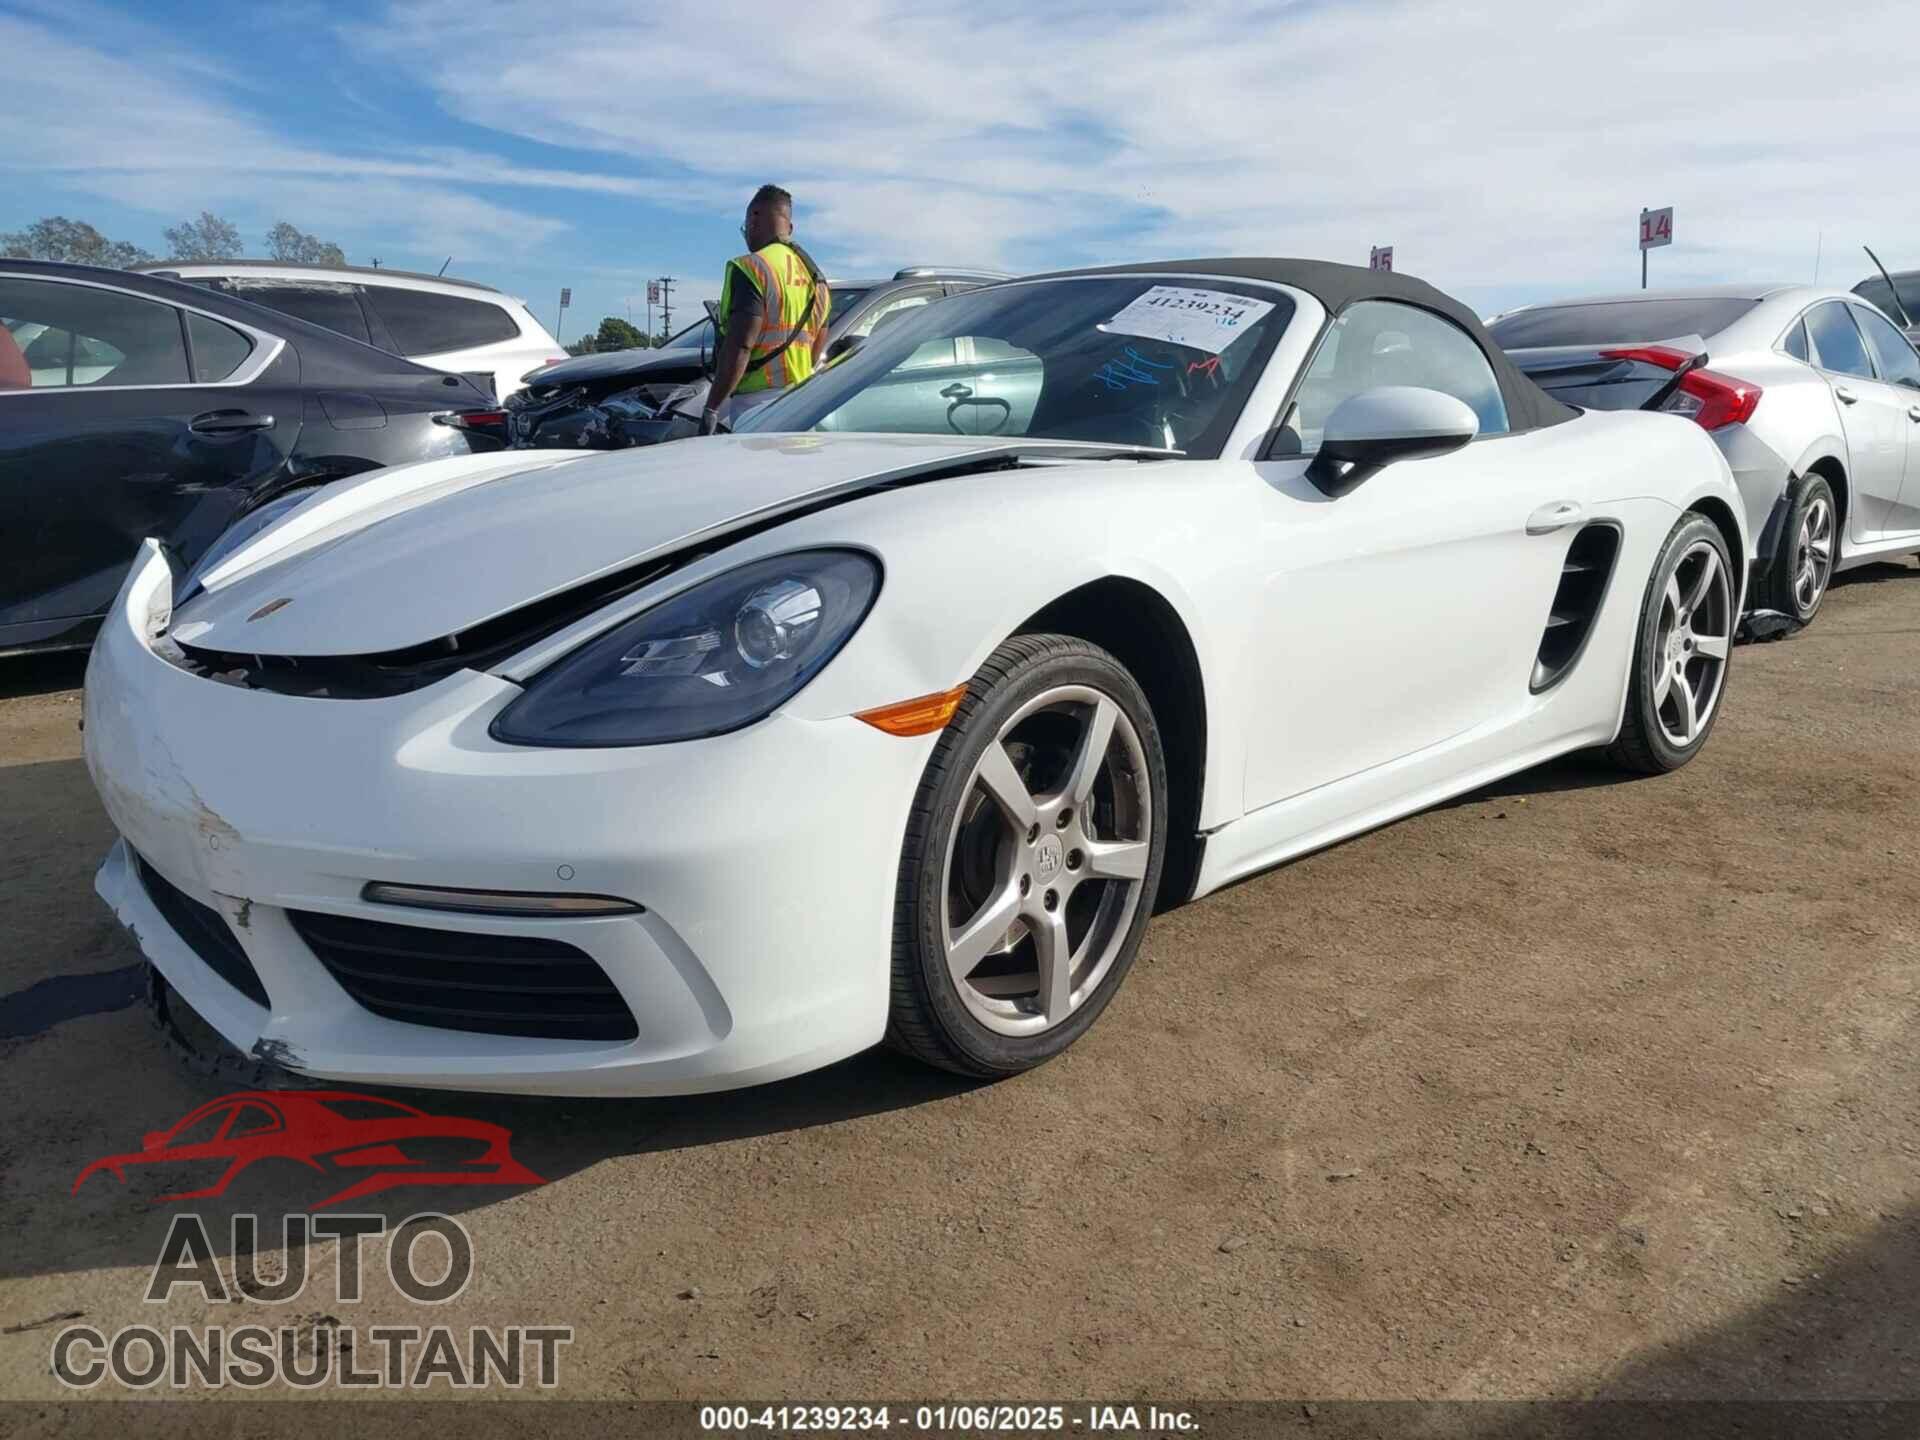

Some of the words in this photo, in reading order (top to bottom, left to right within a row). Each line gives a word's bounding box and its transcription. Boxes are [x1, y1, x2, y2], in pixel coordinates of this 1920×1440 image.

[1641, 215, 1670, 242] 14
[1371, 253, 1392, 270] 15
[1147, 297, 1245, 320] 41239234
